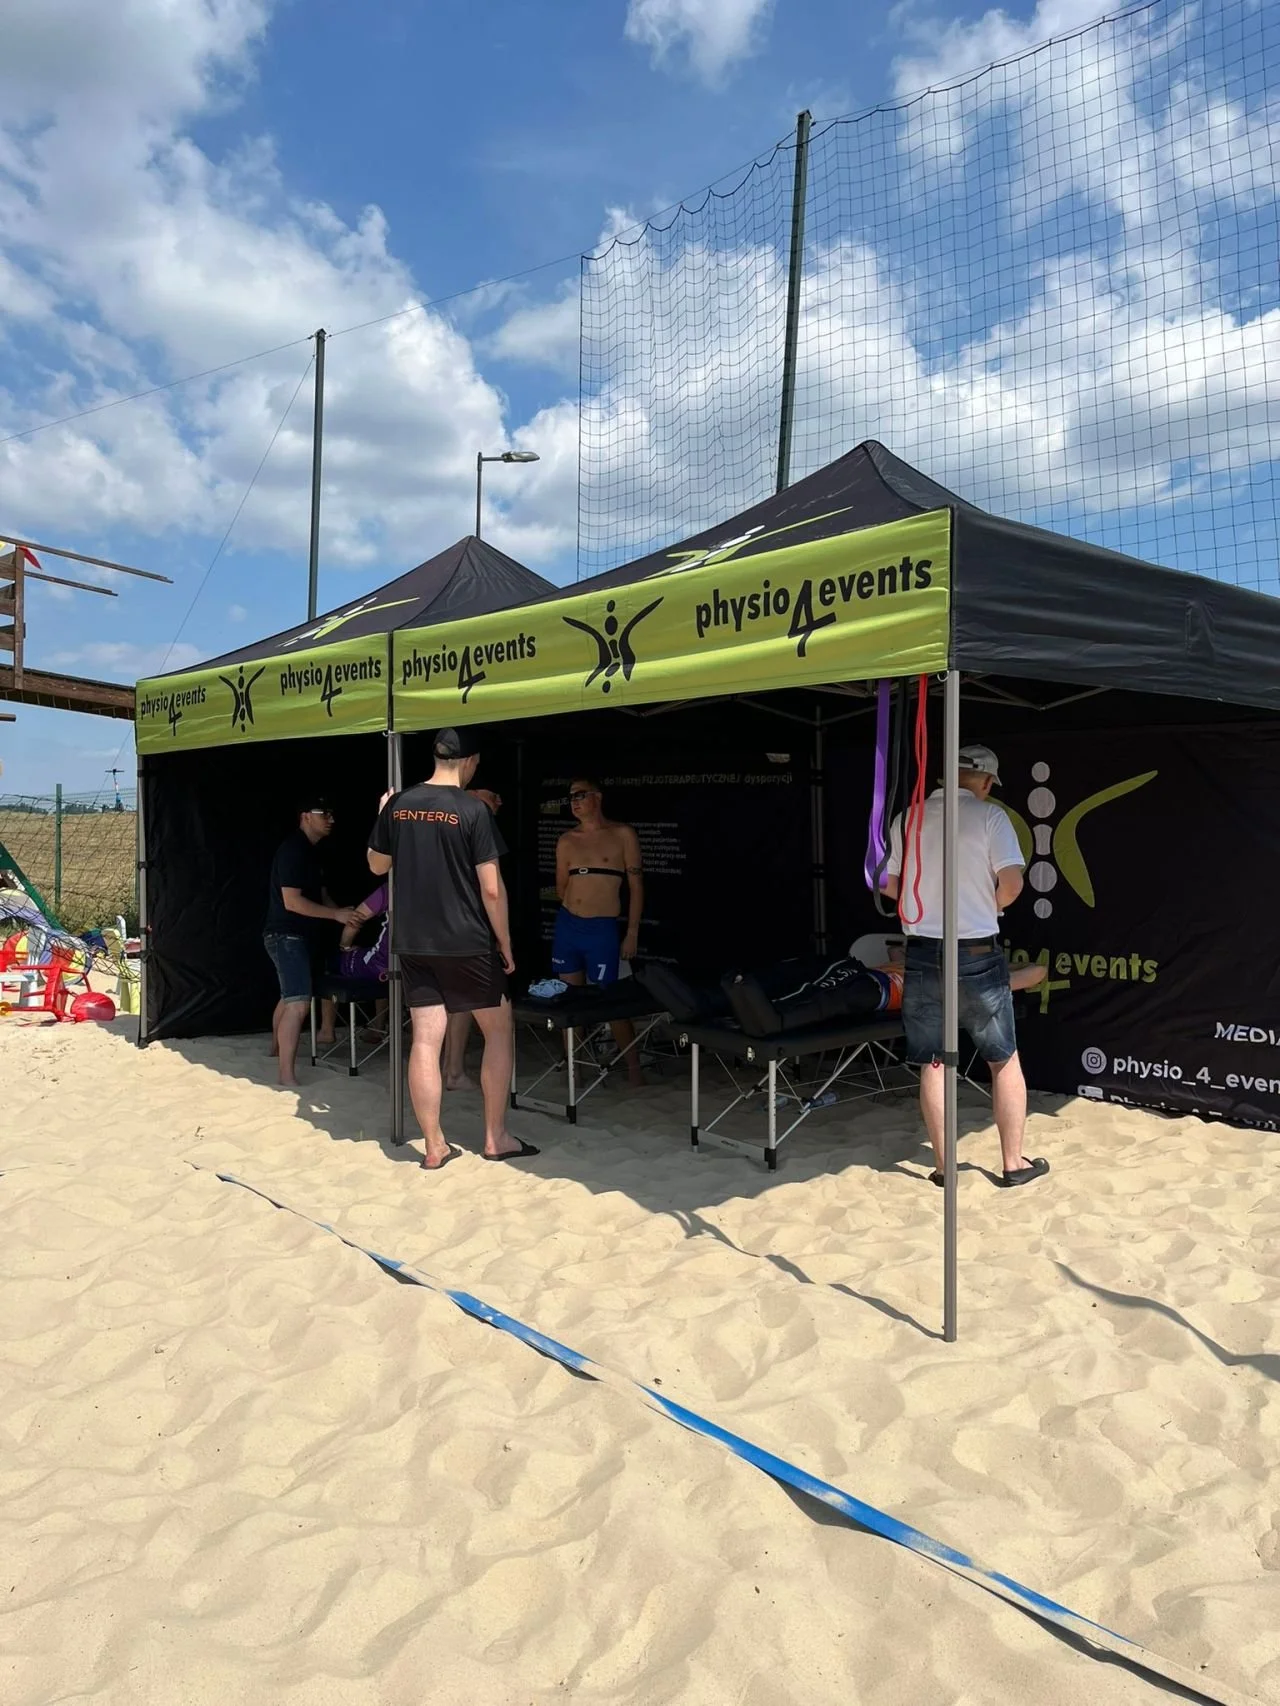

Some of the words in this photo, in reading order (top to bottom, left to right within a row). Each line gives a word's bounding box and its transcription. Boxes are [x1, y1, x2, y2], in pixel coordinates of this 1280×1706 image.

[696, 556, 932, 657] physio4events
[280, 656, 381, 717] physio4events
[402, 632, 536, 703] physio4events
[140, 685, 206, 736] physio4events
[393, 809, 459, 825] PENTERIS
[597, 963, 607, 981] 7
